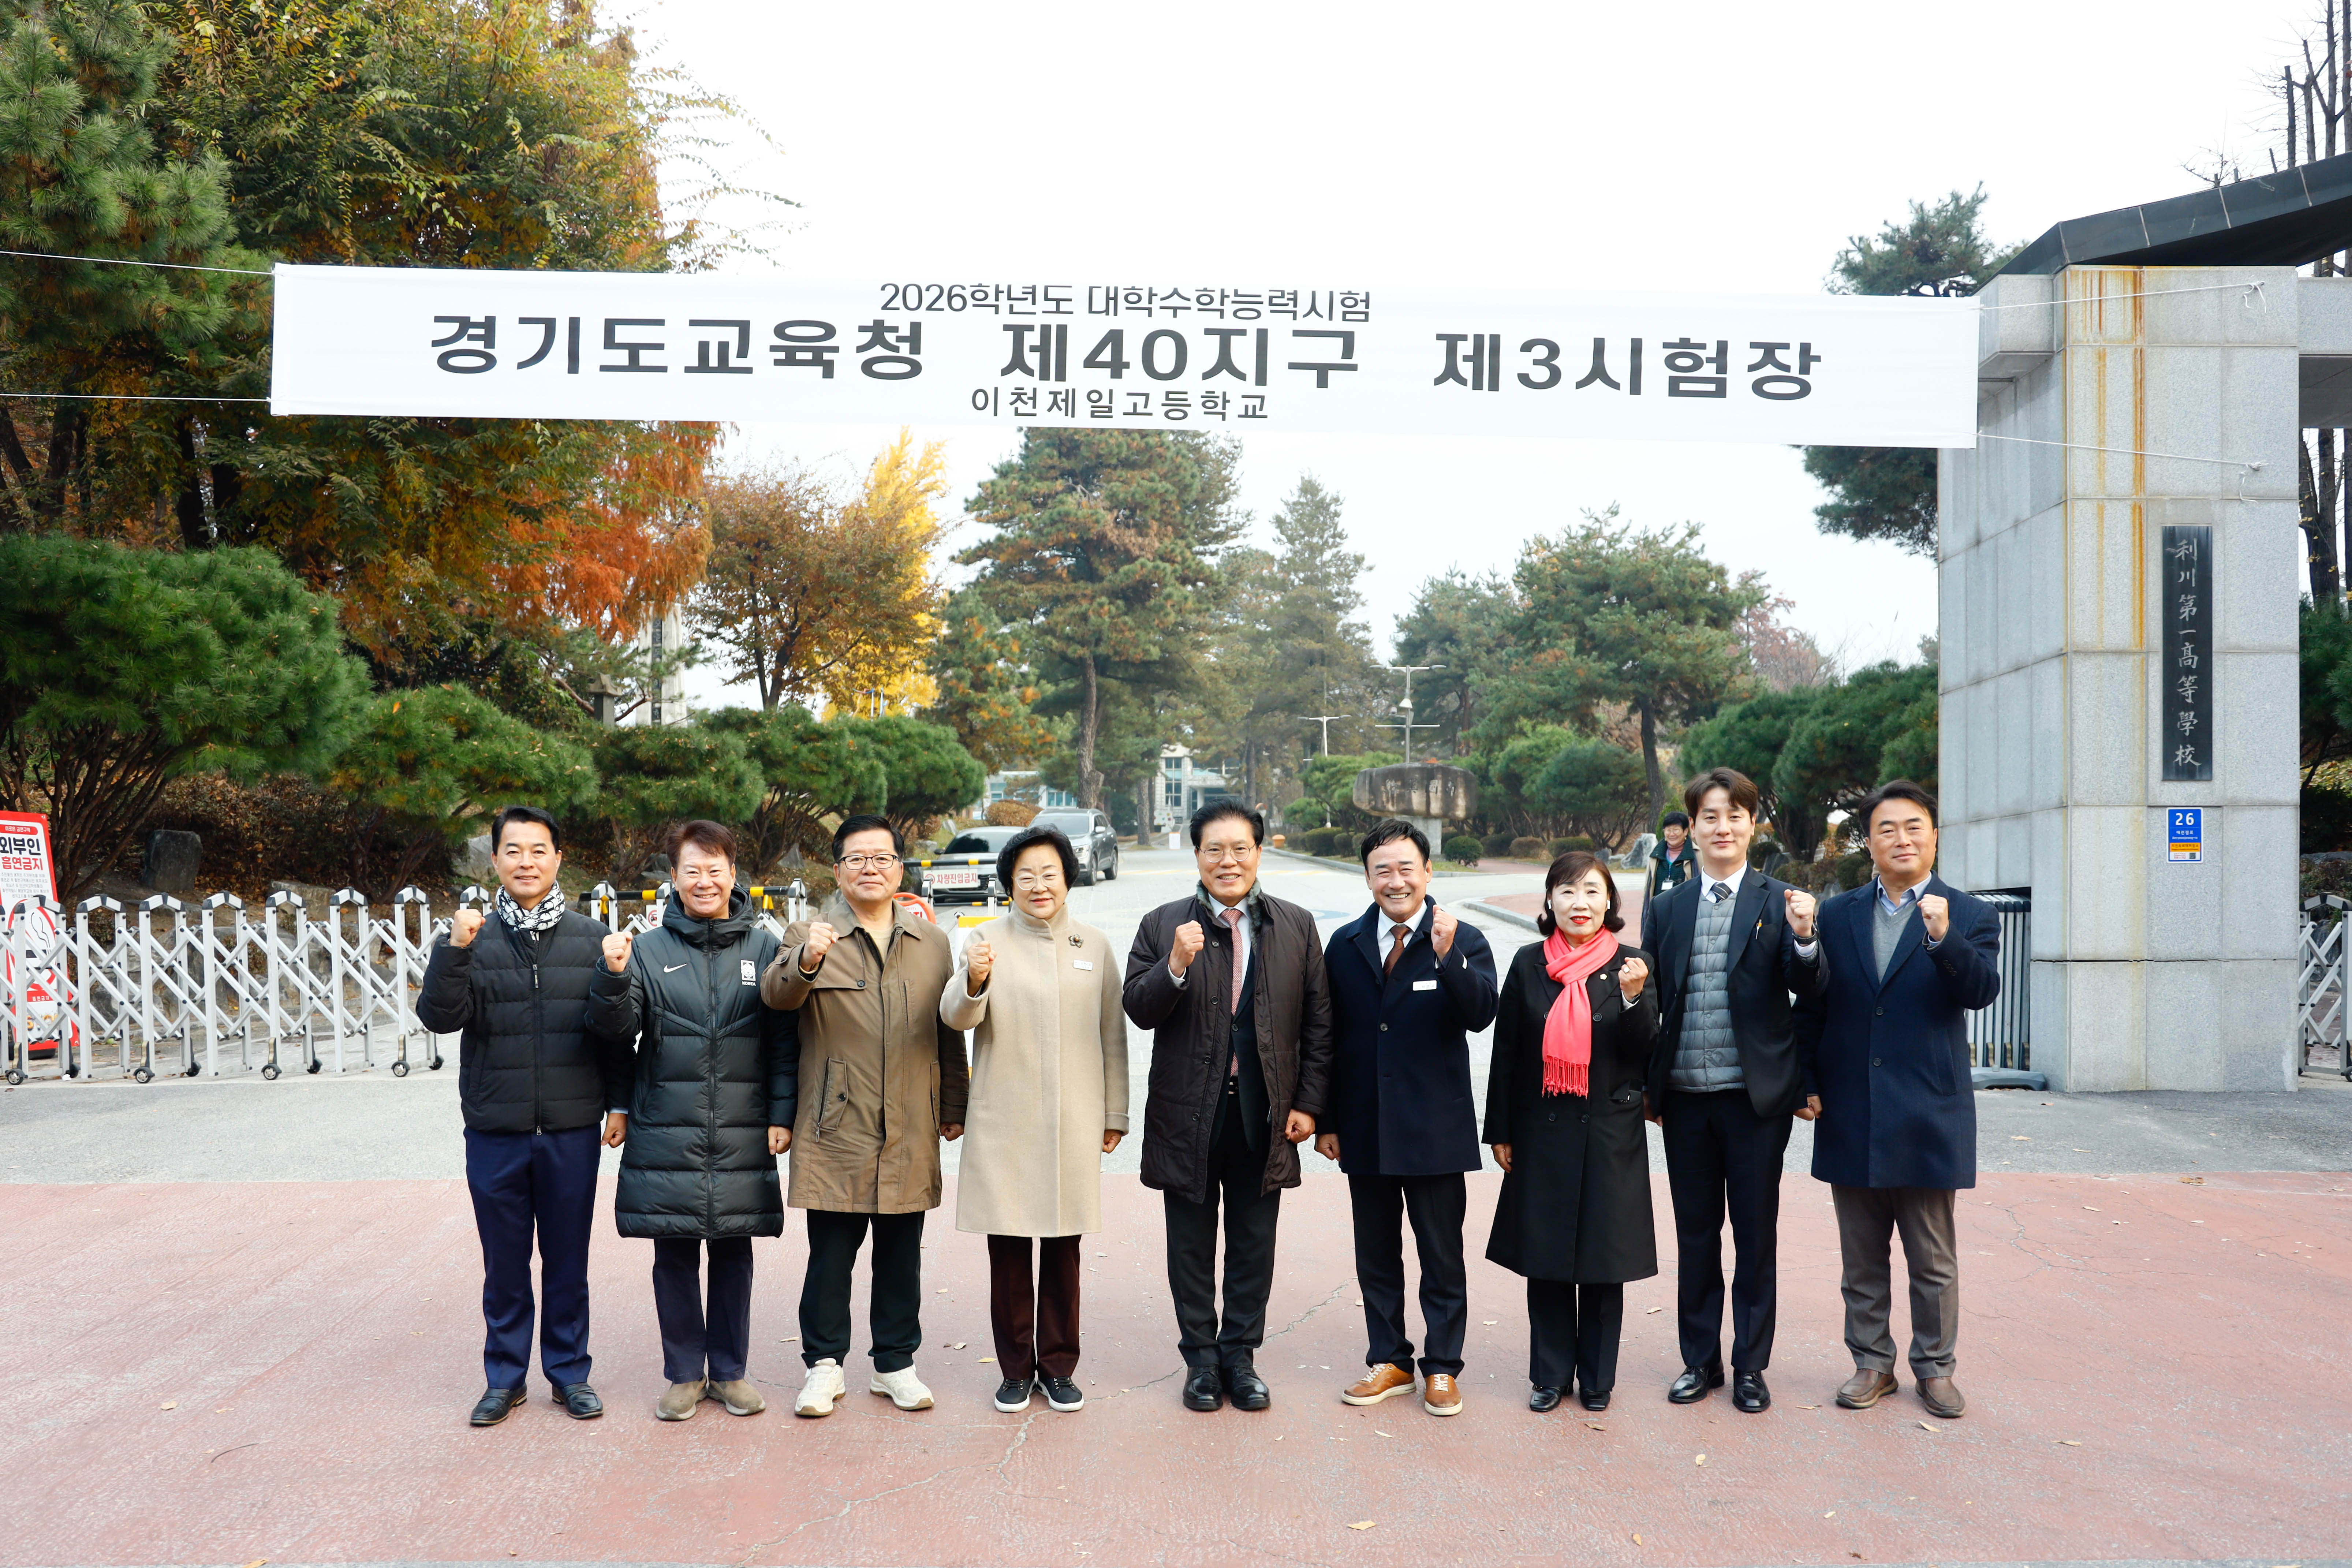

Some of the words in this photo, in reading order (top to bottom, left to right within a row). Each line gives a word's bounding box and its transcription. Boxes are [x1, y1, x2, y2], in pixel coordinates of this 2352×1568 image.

[880, 283, 1074, 315] 2026학년도
[1088, 286, 1370, 322] 대학수학능력시험
[431, 316, 922, 380] 경기도교육청
[1001, 324, 1358, 388] 제40지구
[1434, 334, 1821, 400] 제3시험장
[972, 387, 1268, 421] 이천제일고등학교
[2173, 538, 2202, 766] 利川第一高等學校
[2175, 813, 2194, 826] 26
[0, 837, 41, 855] 외부인
[1, 856, 43, 870] 흡연금지
[937, 873, 977, 884] 차량진입금지
